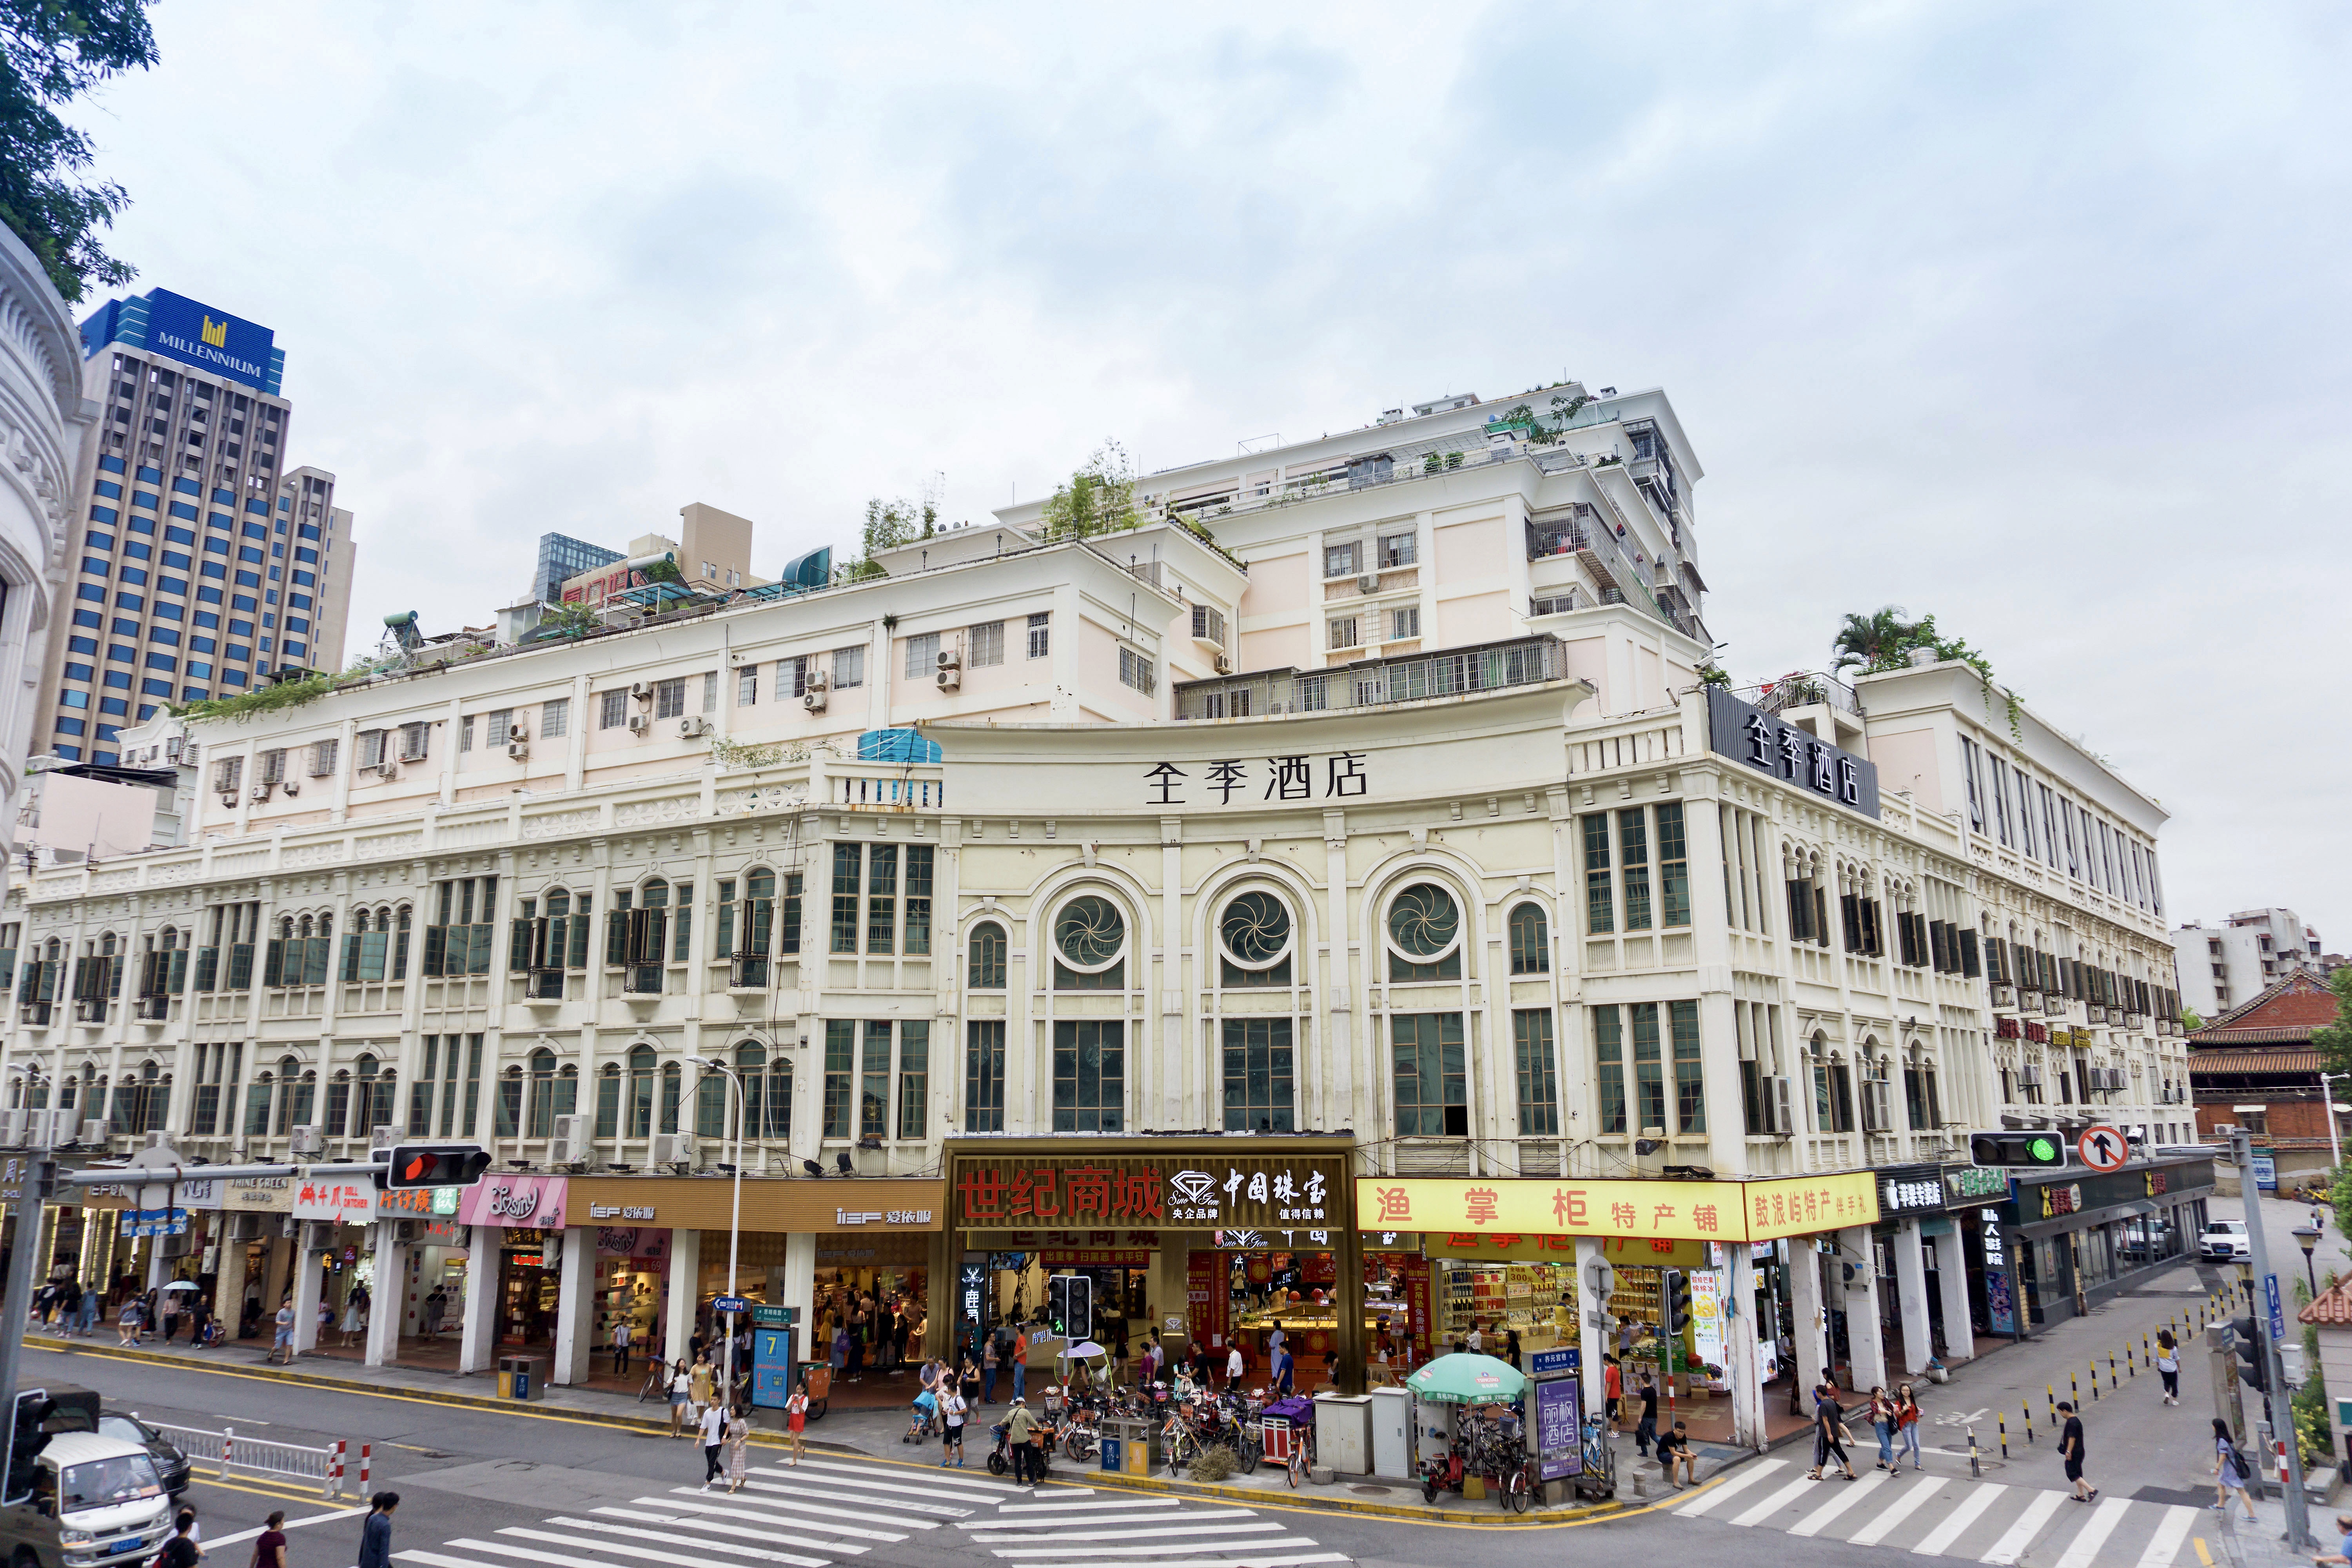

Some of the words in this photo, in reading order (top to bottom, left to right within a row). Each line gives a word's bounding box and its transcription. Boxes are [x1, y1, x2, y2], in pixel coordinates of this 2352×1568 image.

[159, 332, 261, 377] MILLENNIUM
[1744, 714, 1858, 805] 全季酒店
[1143, 751, 1367, 805] 全季酒店
[344, 1186, 358, 1196] DOLL
[957, 1165, 1163, 1219] 世纪商城
[1223, 1168, 1327, 1207] 中国珠宝
[1898, 1181, 1941, 1207] 苹果专卖店
[343, 1198, 368, 1208] CATCHER
[1168, 1190, 1189, 1206] Sino
[1198, 1192, 1220, 1206] Gem
[622, 1207, 655, 1219] 爱依服
[886, 1210, 932, 1223] 爱依服
[1172, 1208, 1218, 1220] 央企品牌
[1279, 1208, 1325, 1220] 值得信赖
[1376, 1187, 1589, 1227] 渔掌柜
[1612, 1202, 1718, 1232] 特产铺
[1755, 1188, 1831, 1228] 鼓浪屿特产
[1837, 1194, 1866, 1218] 伴手礼
[1246, 1234, 1269, 1249] Gem
[1981, 1209, 2004, 1265] 私人影院
[1045, 1251, 1075, 1262] 出重拳
[1080, 1252, 1109, 1262] 扫黑恶
[1114, 1251, 1145, 1262] 保平安
[651, 1260, 662, 1271] 69
[1510, 1274, 1534, 1283] 300元
[2268, 1278, 2275, 1307] P
[767, 1337, 776, 1355] 7
[1545, 1353, 1567, 1363] 养元宫巷
[1436, 1392, 1458, 1401] 青岛啤酒
[1544, 1401, 1574, 1424] 丽枫
[1545, 1423, 1575, 1446] 酒店
